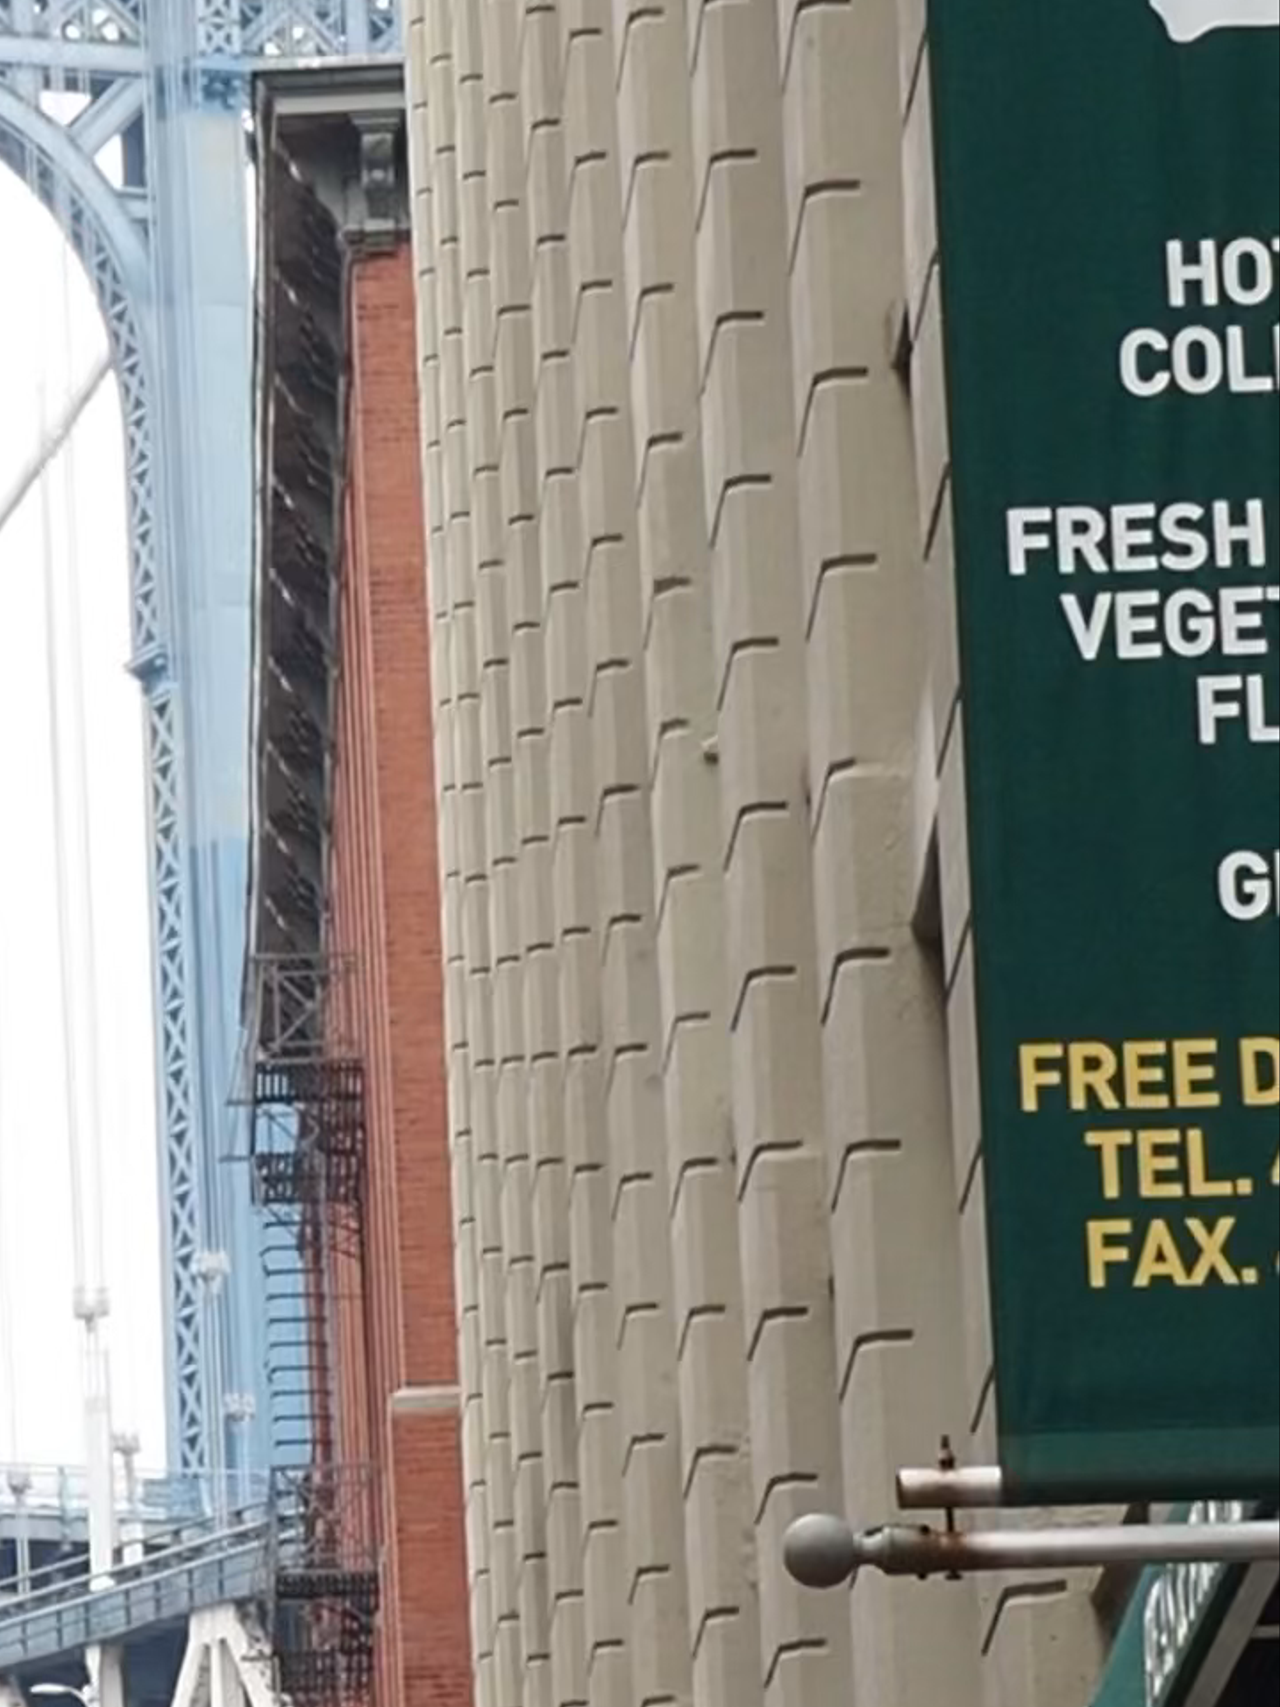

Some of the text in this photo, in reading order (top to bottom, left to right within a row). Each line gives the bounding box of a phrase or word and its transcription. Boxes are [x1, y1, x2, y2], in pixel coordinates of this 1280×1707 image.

[1165, 237, 1280, 308] HO
[1120, 325, 1280, 397] COL
[1006, 498, 1266, 576] FRESH
[1218, 849, 1280, 921] G
[1019, 1039, 1221, 1112] FREE
[1084, 1128, 1253, 1199] TEL.
[1086, 1216, 1258, 1288] FAX.
